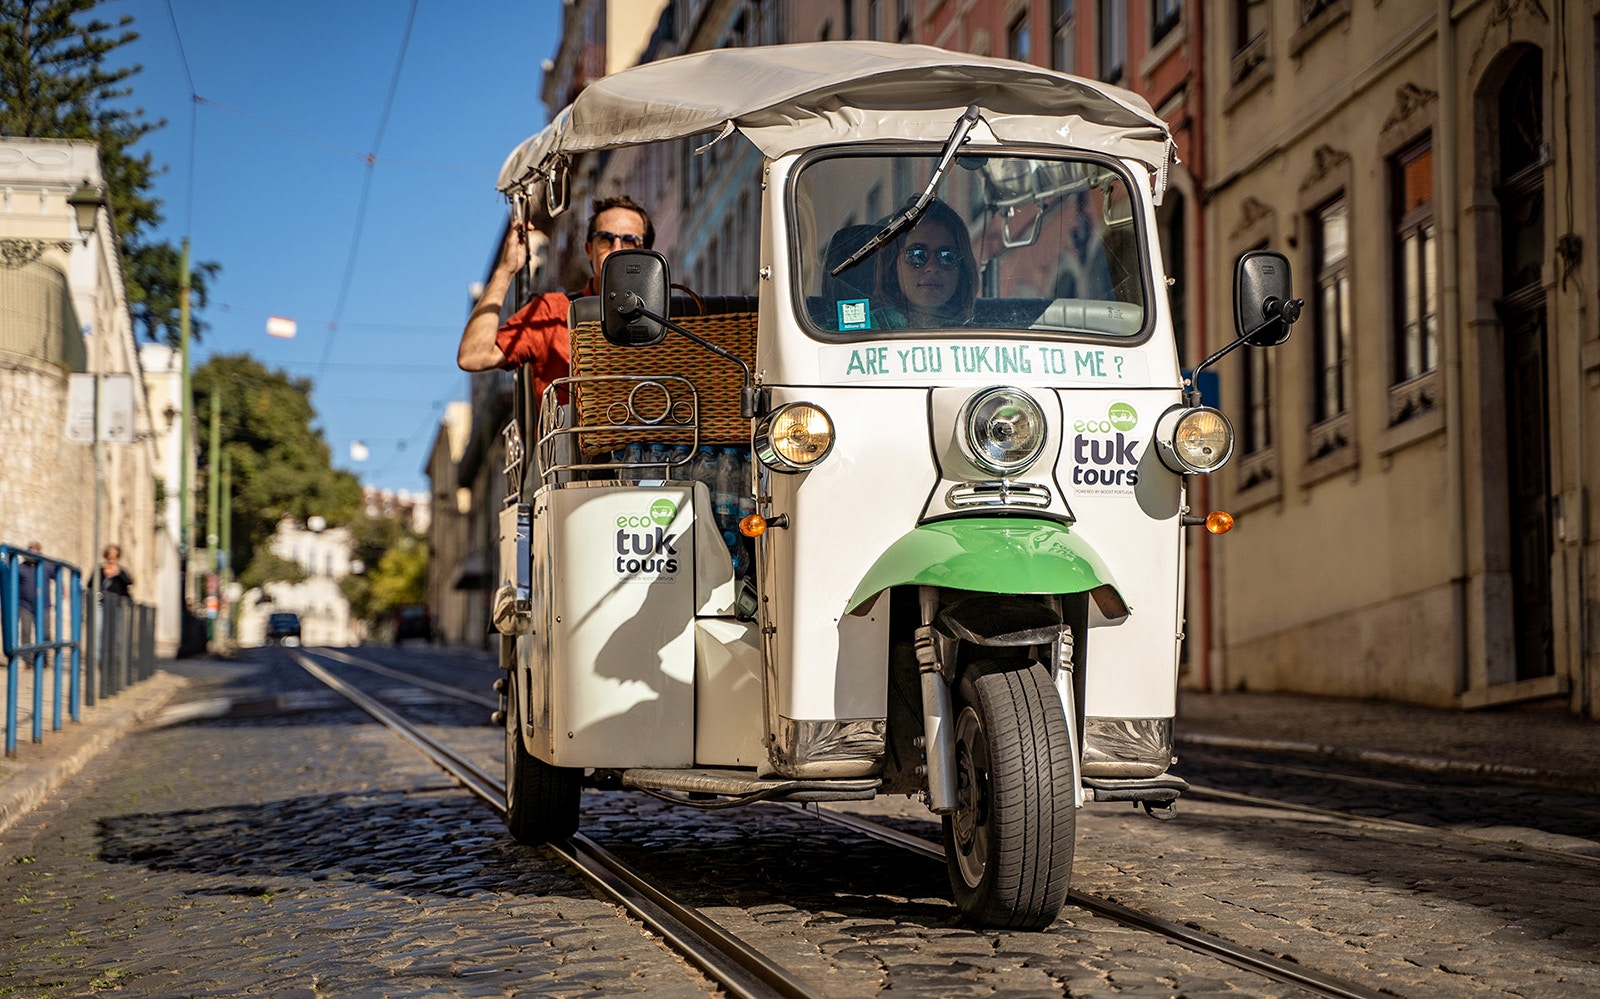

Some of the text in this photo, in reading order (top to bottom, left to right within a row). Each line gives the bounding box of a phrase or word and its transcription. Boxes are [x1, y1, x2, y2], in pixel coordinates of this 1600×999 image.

[846, 345, 1124, 379] ARE YOU TUKING TO ME ?
[1074, 420, 1111, 433] eco
[1074, 433, 1139, 465] tuk
[1073, 465, 1139, 486] tours
[617, 516, 651, 528] eco
[617, 527, 677, 555] tuk
[617, 556, 677, 573] tours
